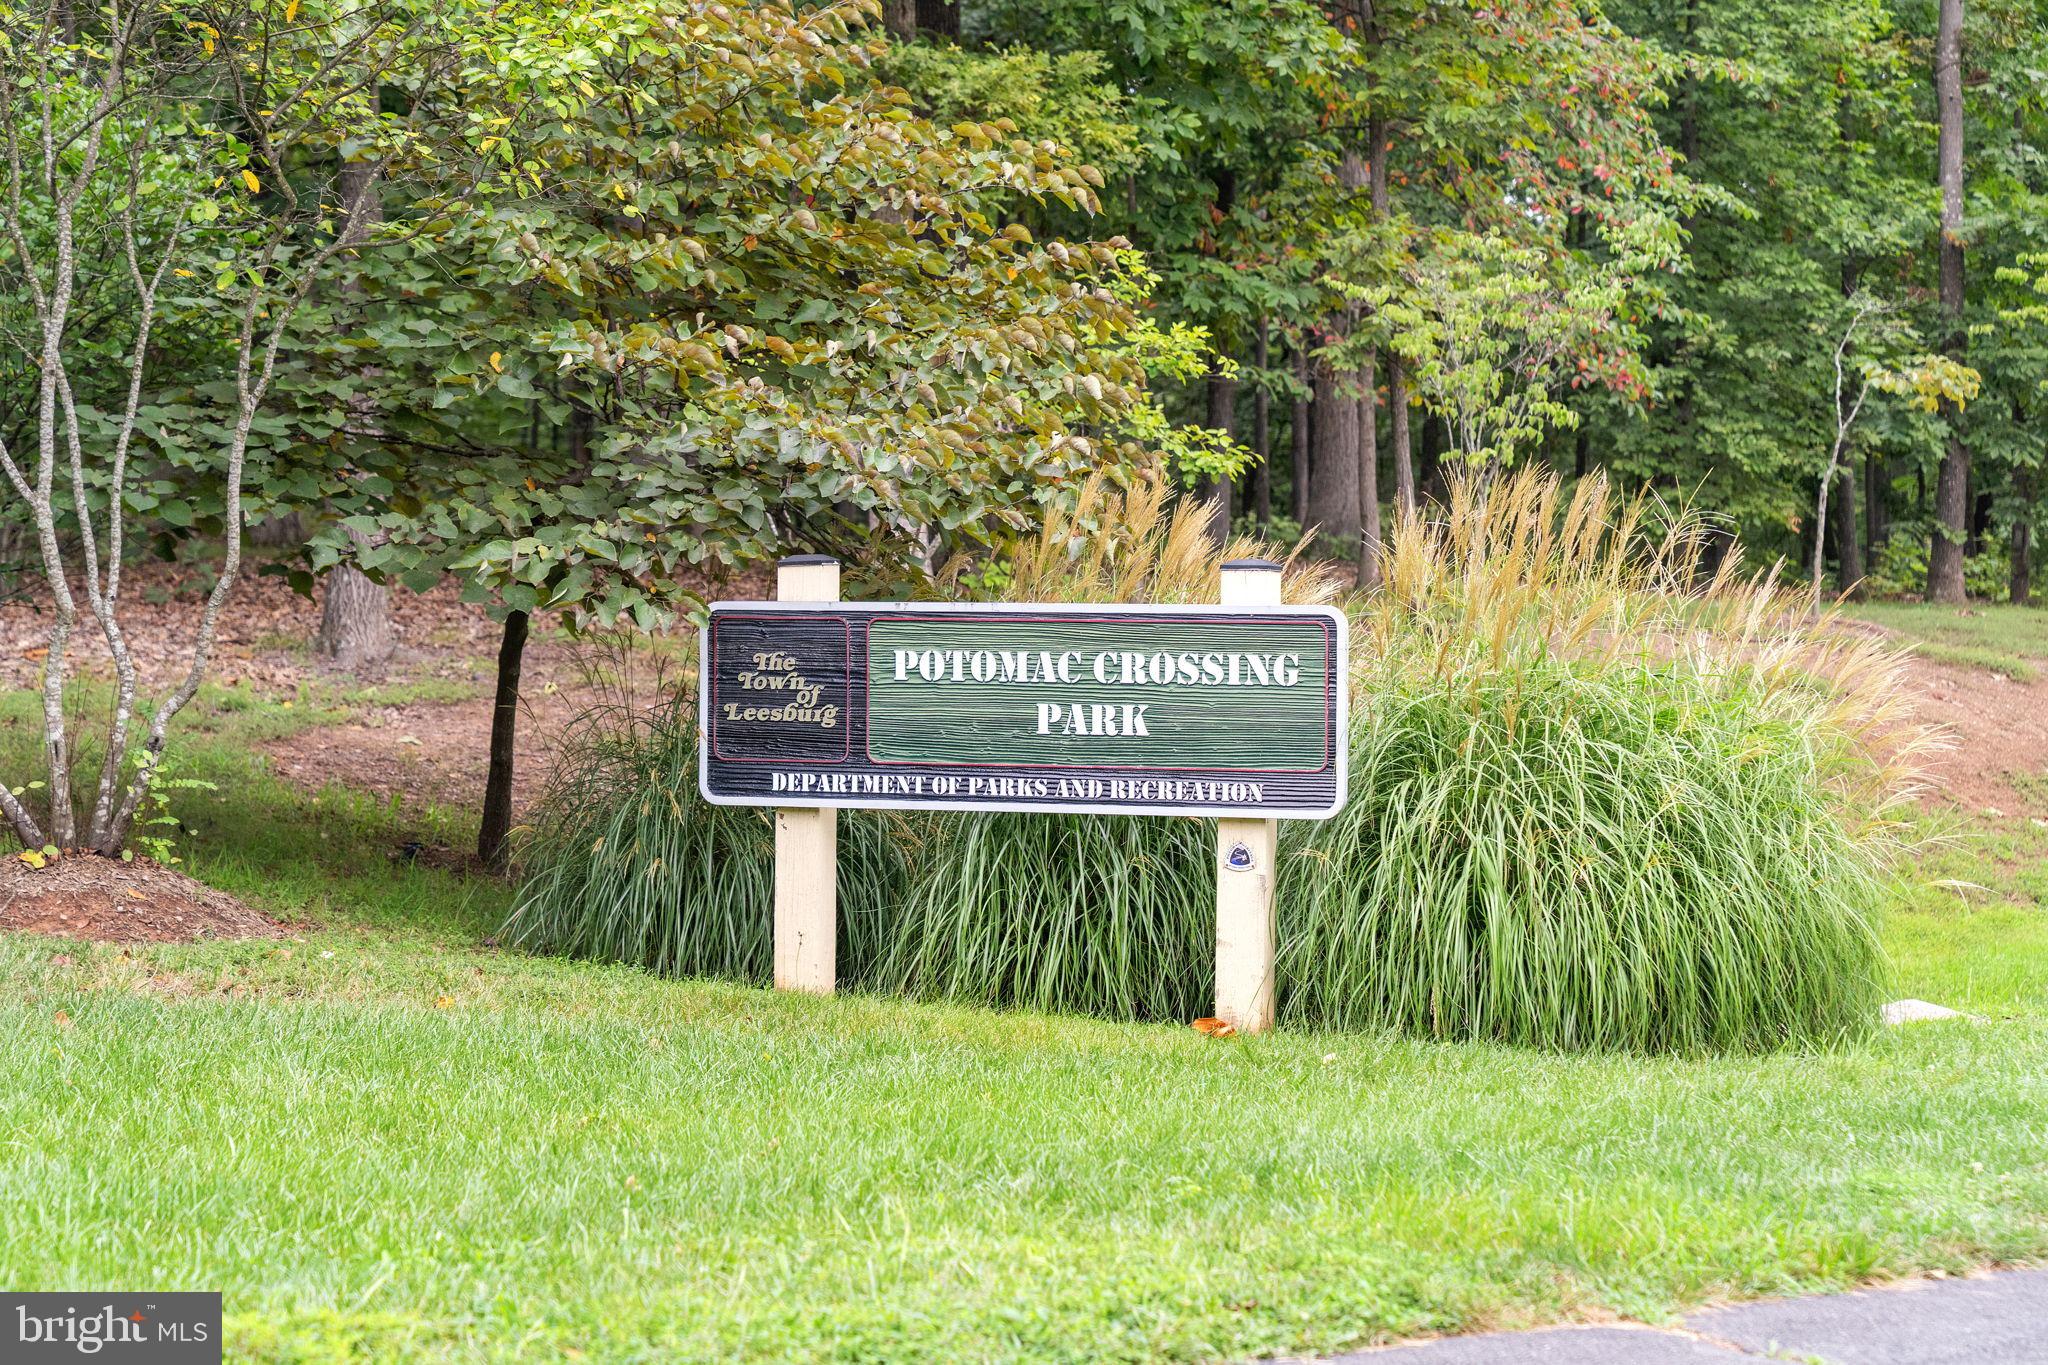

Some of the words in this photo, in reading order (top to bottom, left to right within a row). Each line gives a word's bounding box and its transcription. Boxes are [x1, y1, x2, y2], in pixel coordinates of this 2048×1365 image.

[752, 652, 797, 671] The
[894, 650, 1083, 684] POTOMAC
[1094, 651, 1300, 687] CROSSING
[737, 671, 811, 690] Town
[796, 684, 825, 708] of
[723, 703, 840, 728] Leesburg
[1035, 703, 1150, 737] PARK
[771, 772, 926, 794] DEPARTMENT
[931, 775, 964, 796] OF
[967, 776, 1049, 799] PARKS
[1055, 778, 1104, 799] AND
[1110, 780, 1264, 802] RECREATION
